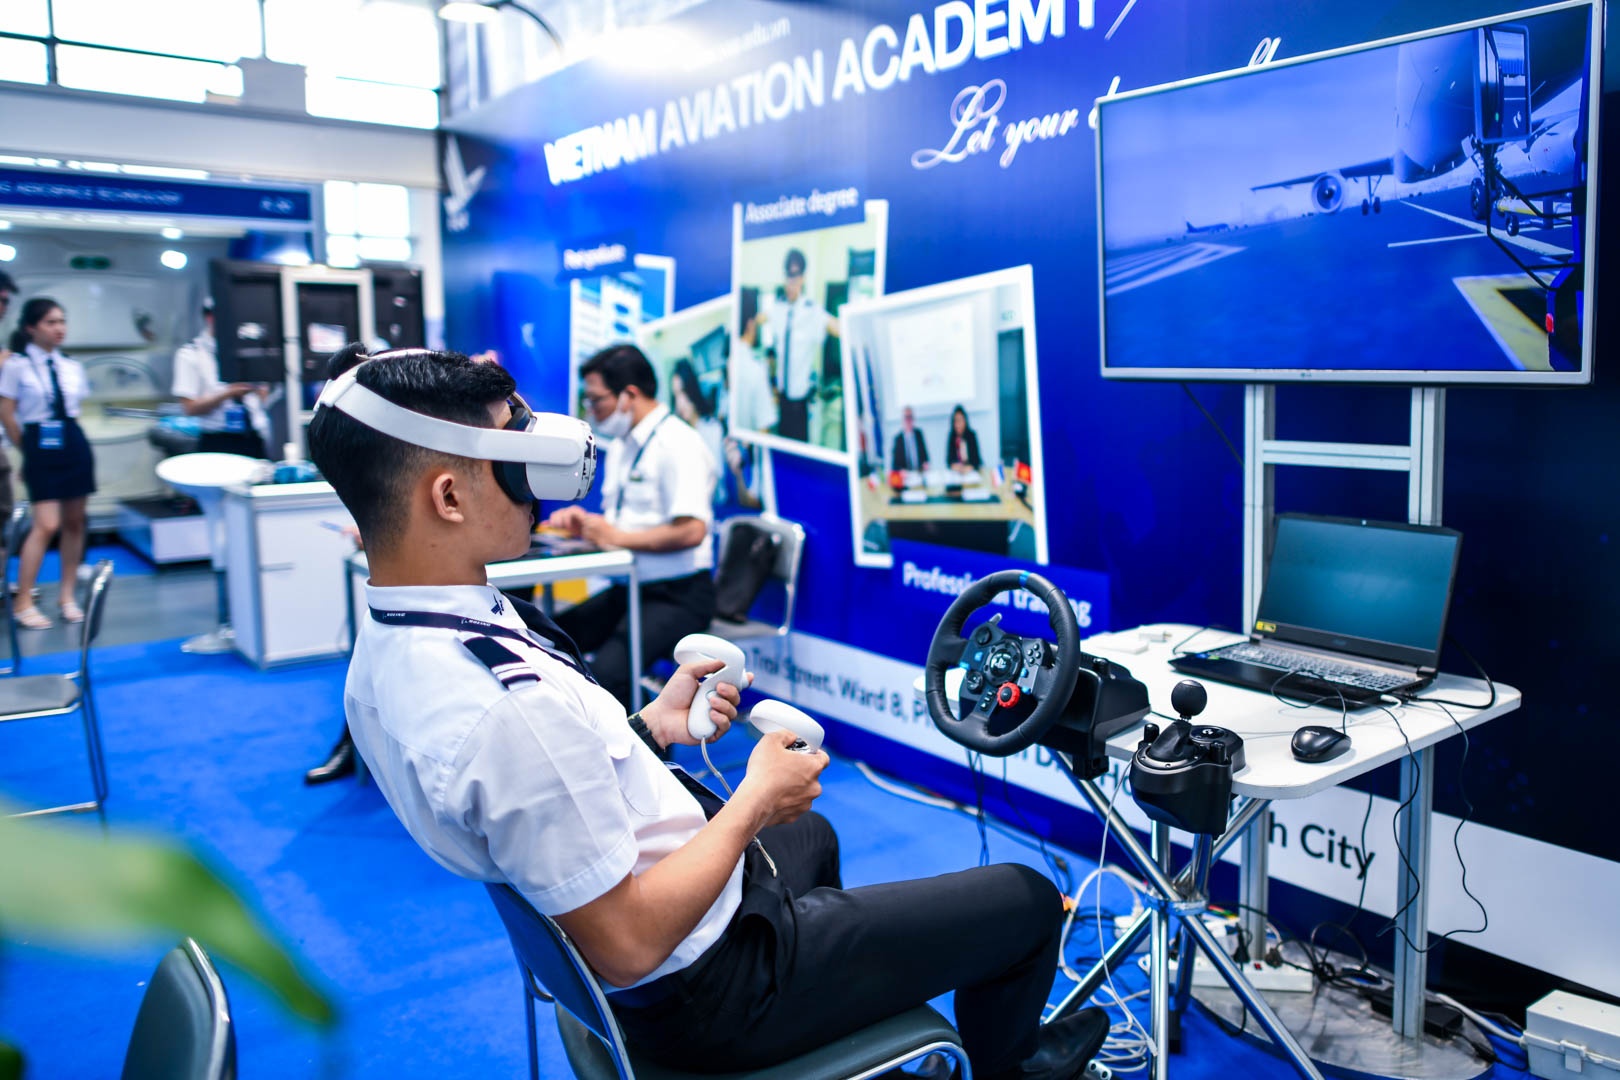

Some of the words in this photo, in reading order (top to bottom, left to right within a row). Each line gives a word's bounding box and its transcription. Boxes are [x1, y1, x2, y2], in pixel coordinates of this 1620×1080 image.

[544, 107, 658, 186] VIETNAM
[659, 49, 825, 154] AVIATION
[910, 78, 1008, 170] Let
[999, 108, 1080, 169] your
[745, 195, 807, 224] Associate
[807, 187, 859, 216] degree
[838, 674, 885, 713] Ward
[1300, 823, 1376, 880] City
